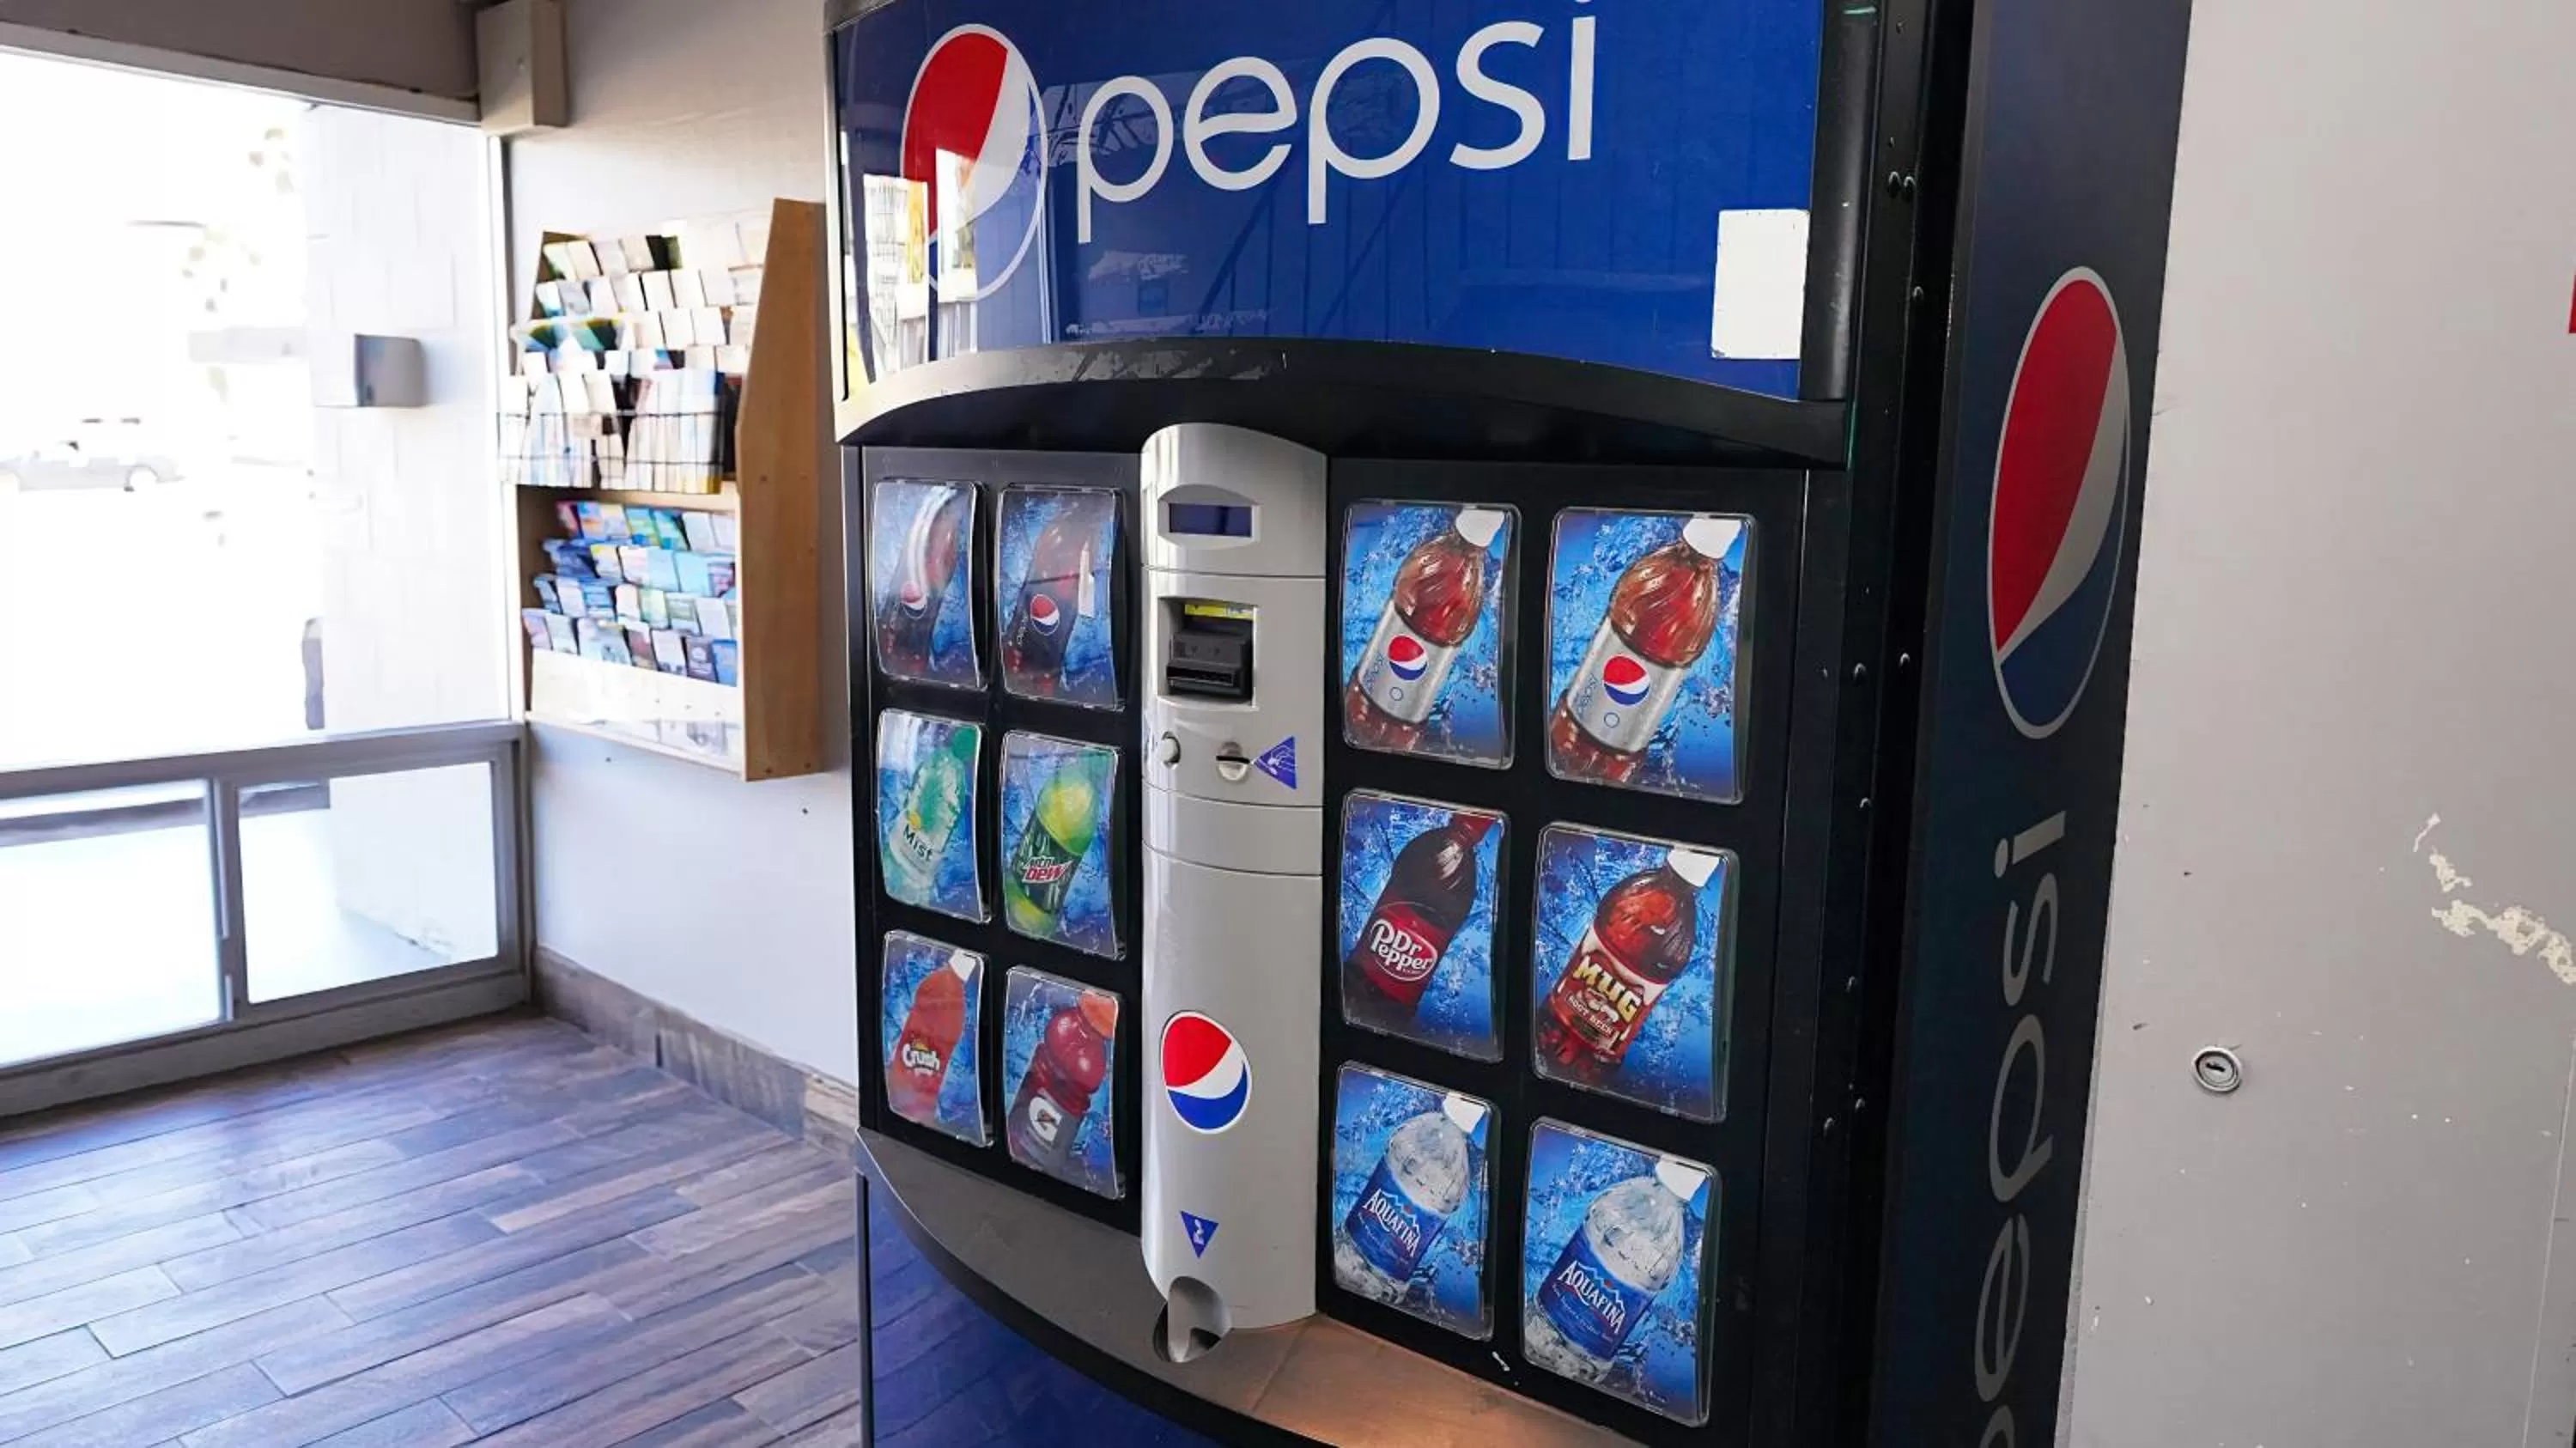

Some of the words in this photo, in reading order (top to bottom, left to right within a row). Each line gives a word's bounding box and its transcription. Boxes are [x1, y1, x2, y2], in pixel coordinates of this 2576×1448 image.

[1077, 0, 1596, 245] pepsi
[903, 823, 933, 861] Mist
[1370, 918, 1433, 970] Pepper
[1392, 928, 1423, 955] Dr
[1572, 955, 1643, 1024] MUG
[1975, 810, 2065, 1448] epsi
[1362, 1189, 1420, 1258] AQUAFINA
[1557, 1260, 1625, 1334] AQUAFINA
